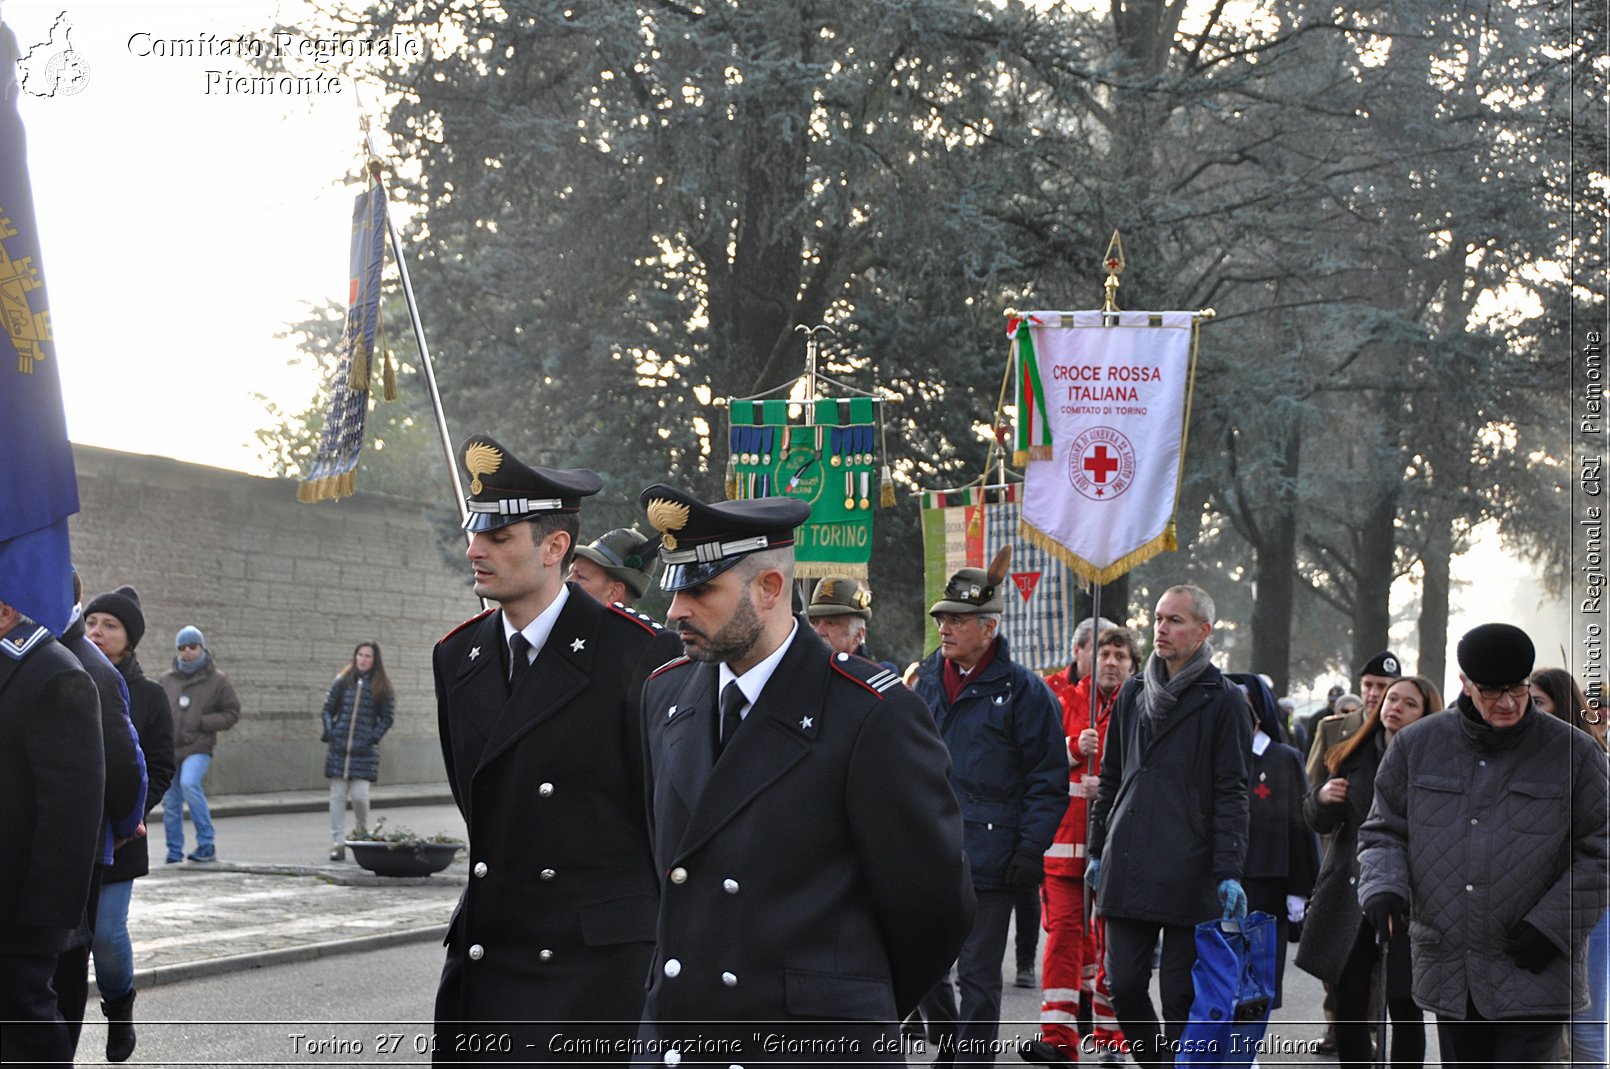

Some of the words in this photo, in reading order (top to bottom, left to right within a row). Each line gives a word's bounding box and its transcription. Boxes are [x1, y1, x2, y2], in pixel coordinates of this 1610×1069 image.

[1053, 365, 1102, 381] CROCE
[1107, 366, 1161, 382] ROSSA
[1068, 386, 1139, 402] ITALIANA
[1061, 405, 1101, 415] COMITATO
[1103, 406, 1112, 415] DI
[1116, 406, 1148, 416] TORINO
[811, 525, 867, 547] TORINO
